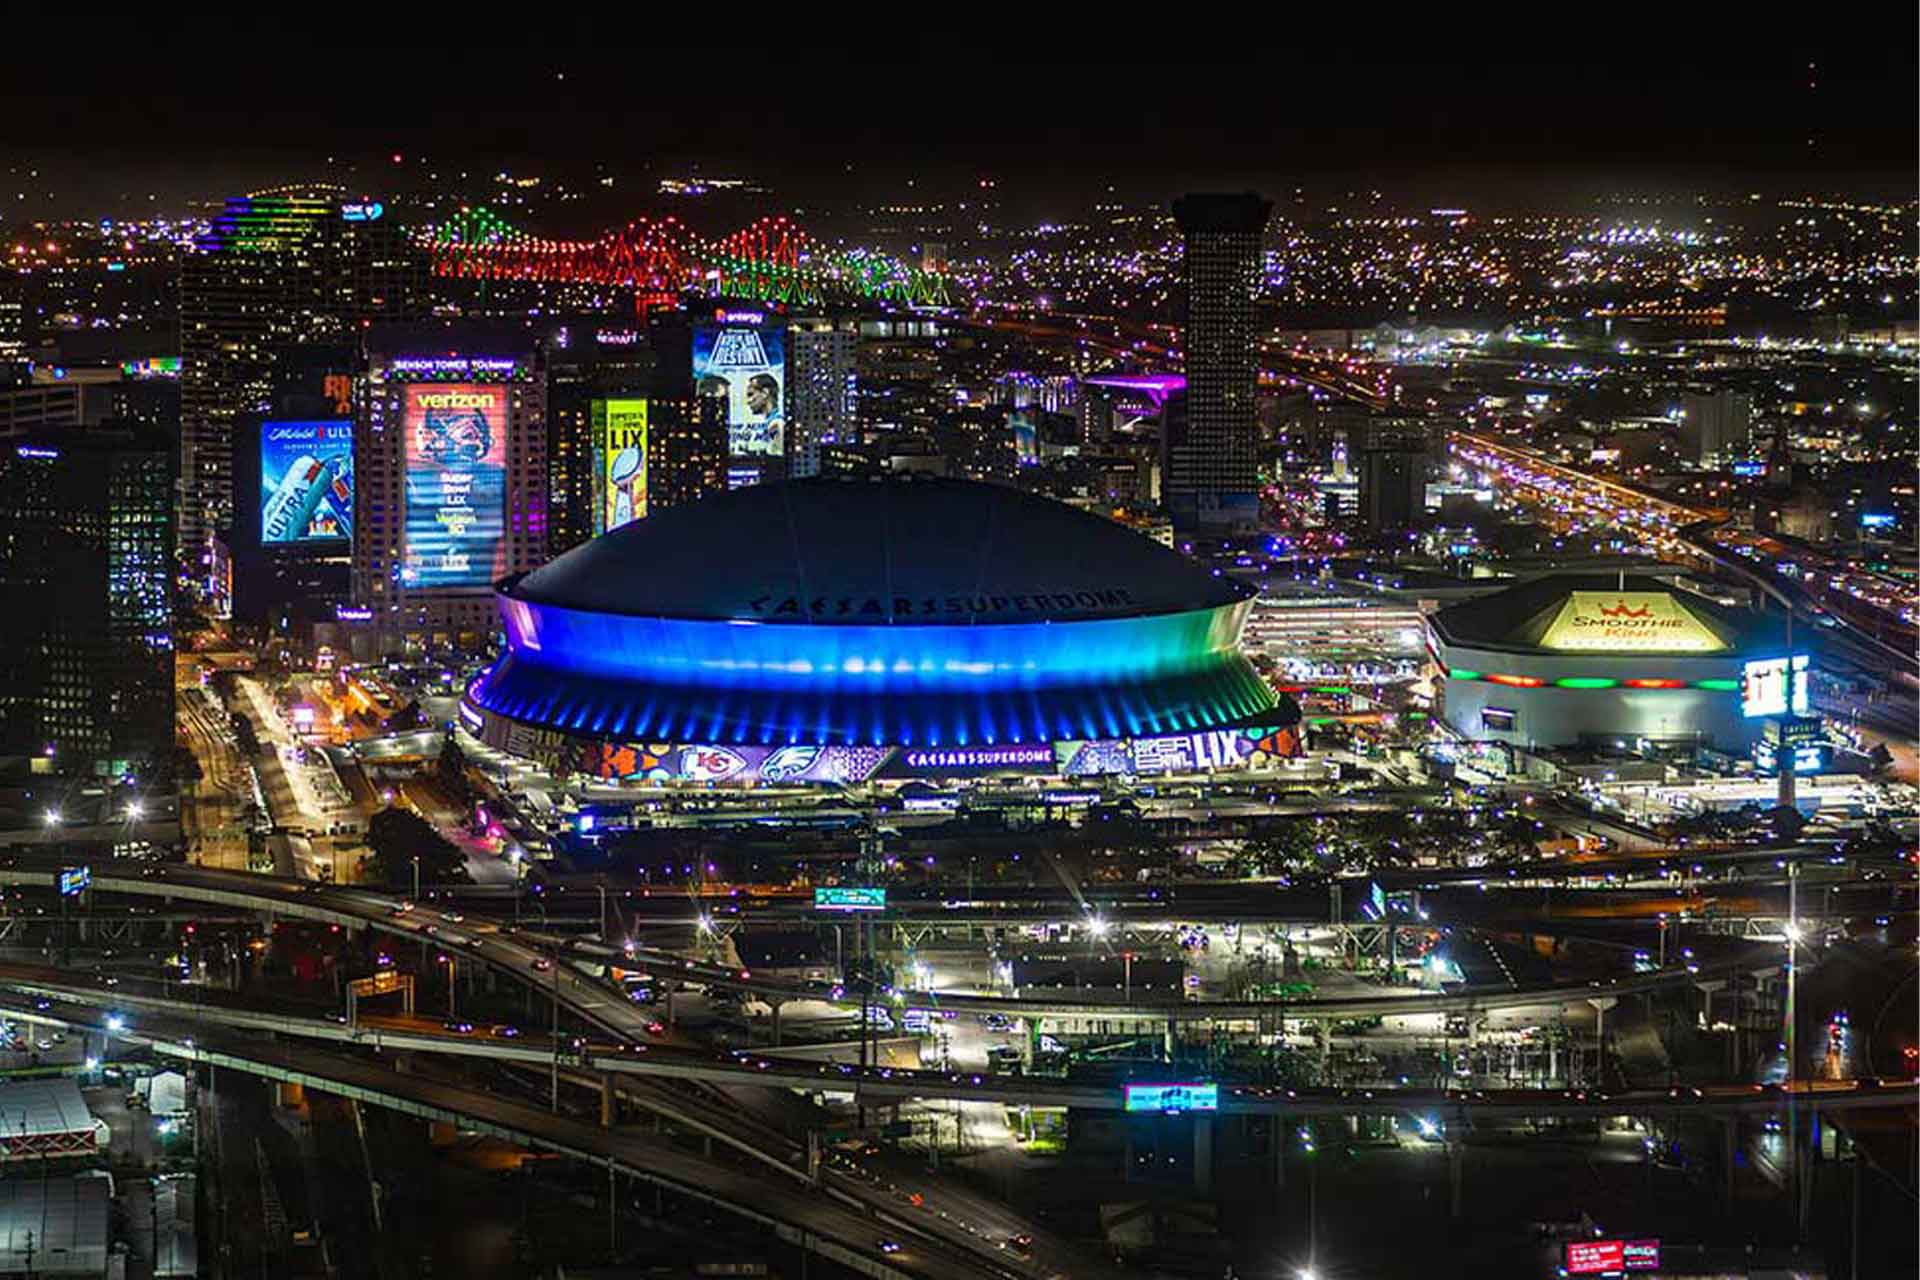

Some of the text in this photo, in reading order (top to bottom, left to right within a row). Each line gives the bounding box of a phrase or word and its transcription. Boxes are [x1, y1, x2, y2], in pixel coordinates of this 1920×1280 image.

[417, 389, 496, 409] verizon
[610, 430, 643, 450] LIX
[266, 487, 308, 538] ULTRA
[1572, 616, 1684, 638] SMOOTHIE KING
[907, 750, 1051, 767] CAESARS SUPERDOME
[1192, 731, 1242, 768] LIX
